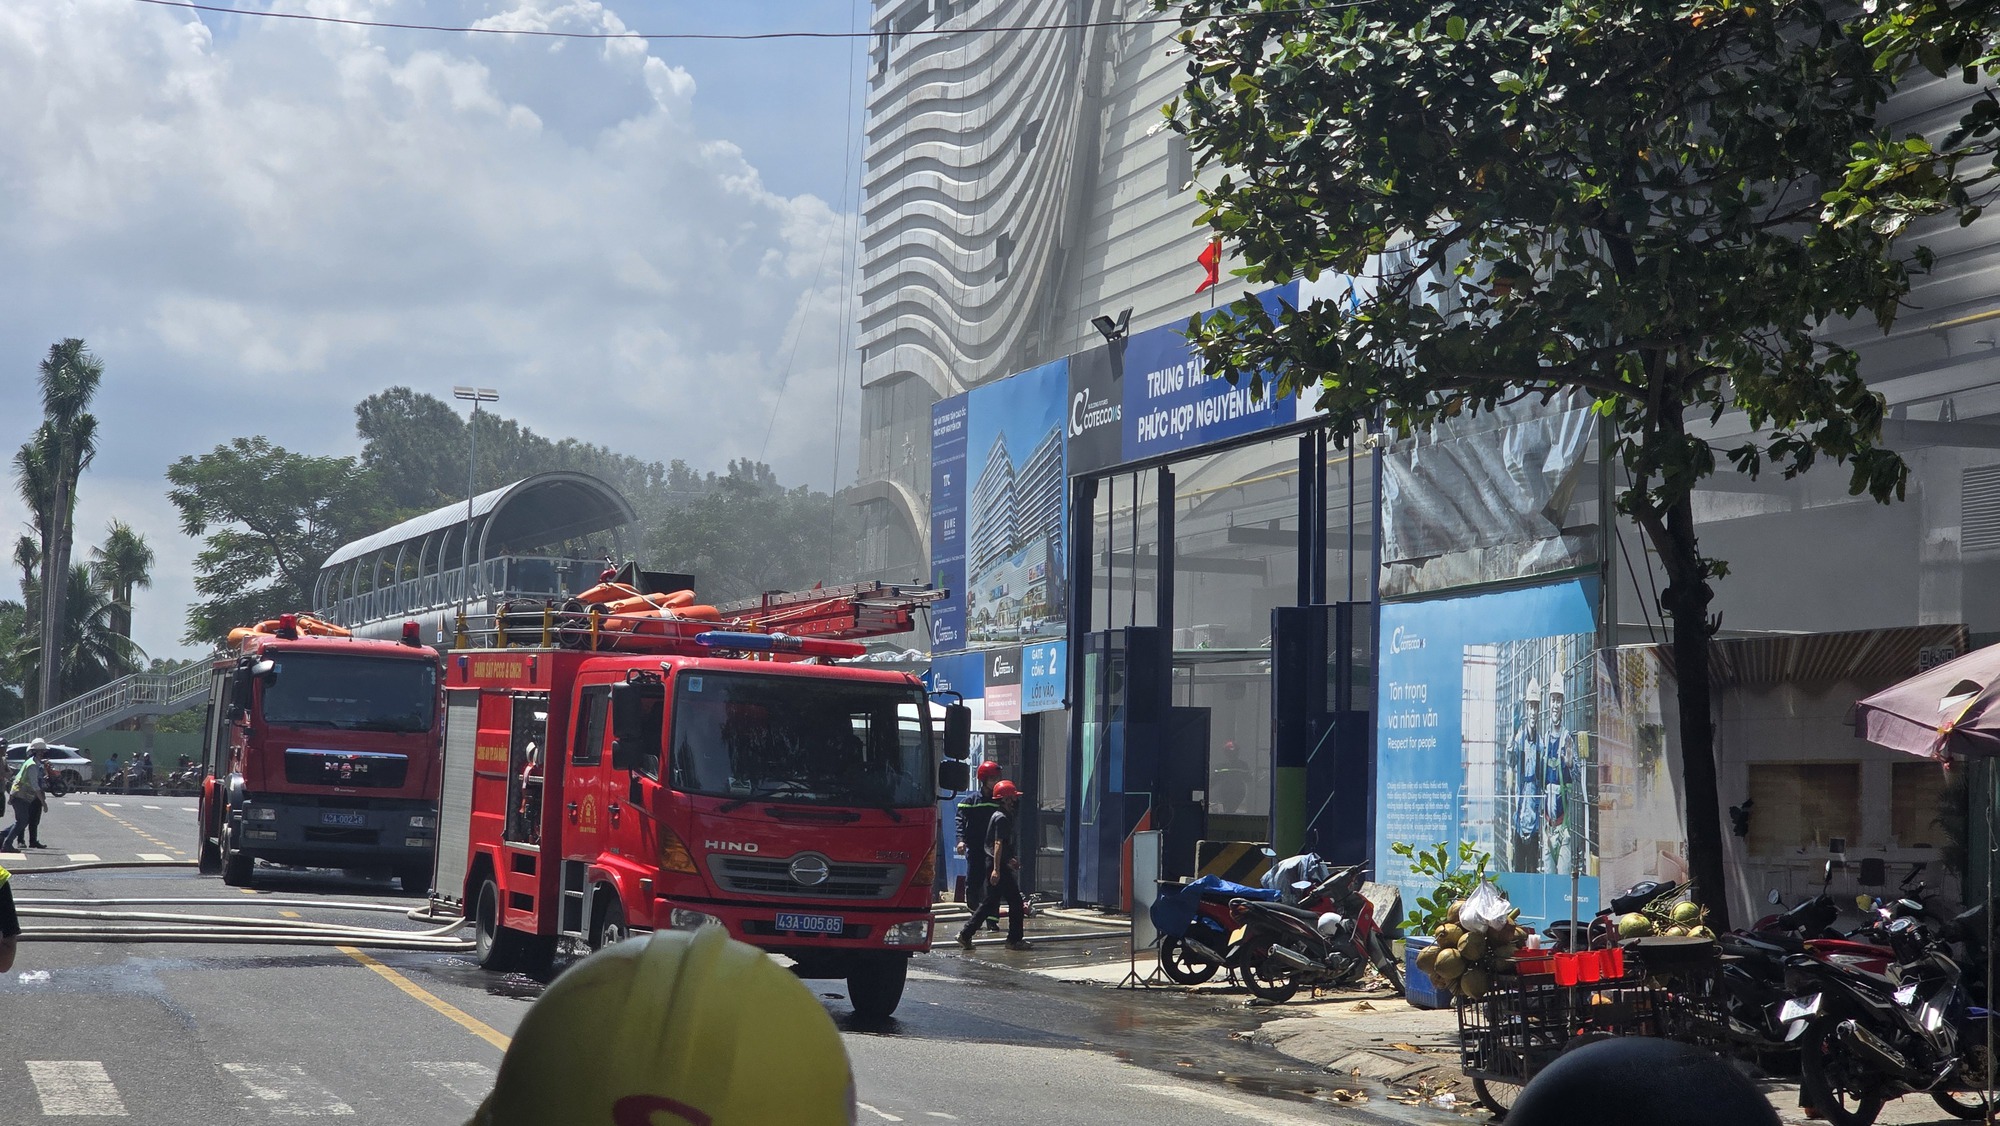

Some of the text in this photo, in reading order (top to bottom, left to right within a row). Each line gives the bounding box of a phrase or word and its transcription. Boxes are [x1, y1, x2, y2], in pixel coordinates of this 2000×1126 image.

[1147, 364, 1184, 399] TRUNG
[1084, 404, 1122, 430] COTECCONS
[1138, 406, 1168, 442] PHỨC
[1170, 404, 1194, 440] HỢP
[1246, 382, 1272, 414] KM
[1031, 648, 1044, 660] GATE
[1049, 647, 1057, 675] 2
[1389, 682, 1427, 704] Tôn trọng
[1388, 707, 1438, 729] và nhân văn
[1388, 737, 1408, 752] Respect
[1417, 736, 1436, 751] people
[325, 762, 368, 772] MAN
[705, 840, 758, 852] HINO
[778, 914, 841, 932] 43A-005.85
